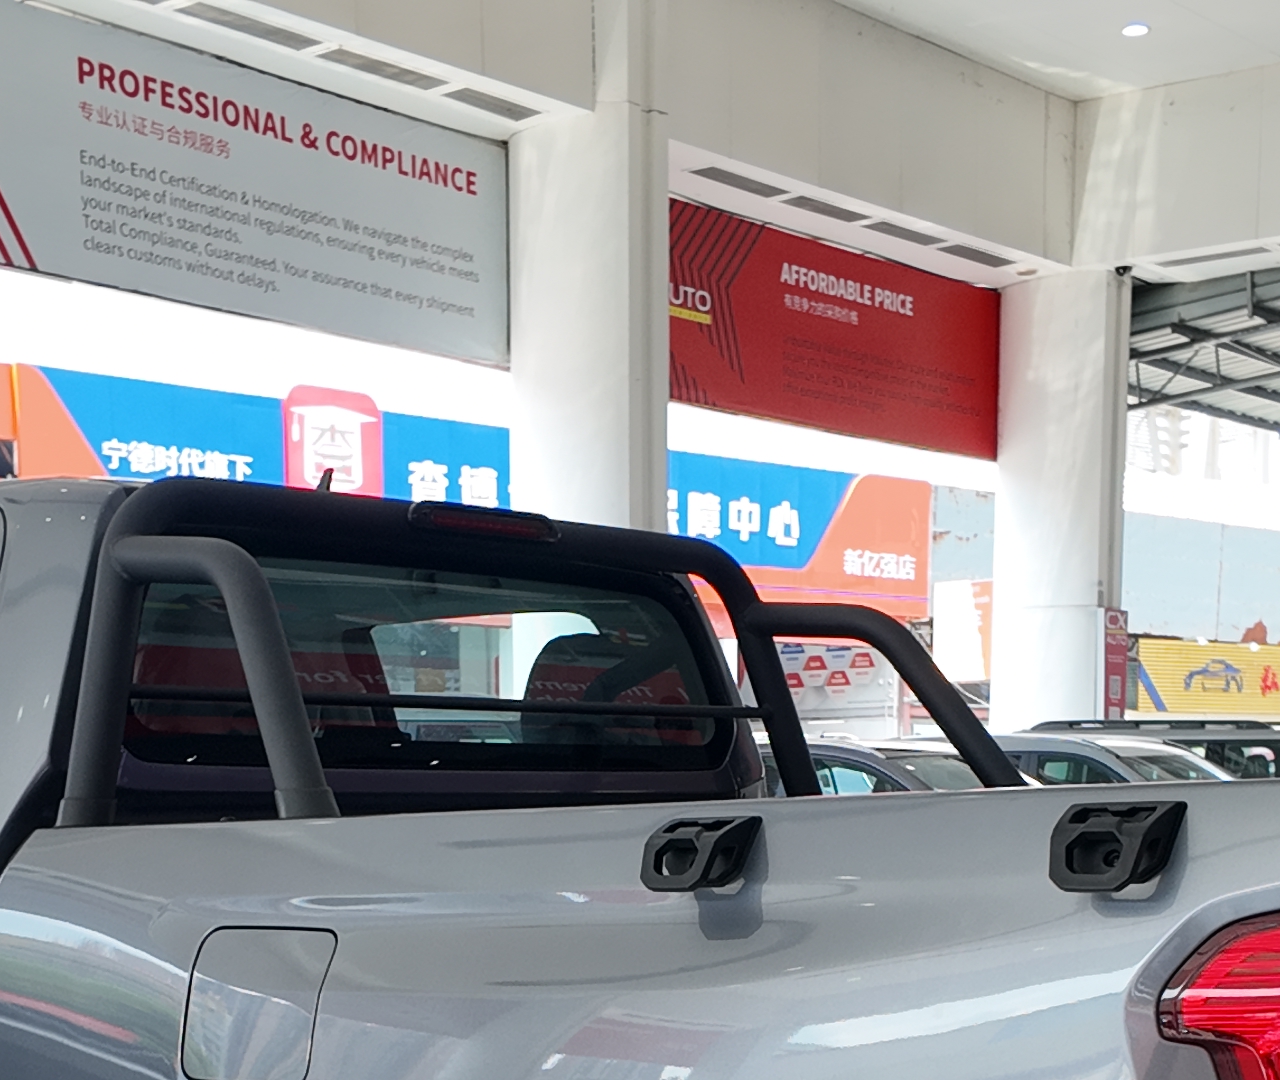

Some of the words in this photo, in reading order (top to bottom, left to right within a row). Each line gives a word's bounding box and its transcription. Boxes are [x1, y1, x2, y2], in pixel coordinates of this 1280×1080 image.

[77, 55, 294, 144] PROFESSIONAL
[300, 122, 320, 151] &
[325, 130, 479, 196] COMPLIANCE
[77, 100, 232, 161] 专业认证与合规服务
[79, 149, 157, 183] End-to-End
[159, 169, 238, 204] Certification
[239, 190, 250, 206] &
[251, 193, 341, 230] Homologation.
[341, 216, 360, 235] We
[362, 225, 409, 248] navigate
[410, 235, 429, 253] the
[429, 242, 475, 264] complex
[79, 169, 151, 202] landscape
[152, 189, 167, 205] of
[169, 191, 252, 227] international
[253, 216, 324, 248] regulations,
[325, 234, 376, 261] ensuring
[377, 248, 407, 269] every
[408, 256, 447, 275] vehicle
[448, 265, 480, 283] meets
[80, 195, 113, 213] your
[115, 202, 174, 228] market's
[175, 217, 243, 245] standards.
[81, 213, 117, 236] Total
[119, 221, 203, 258] Compliance,
[203, 242, 281, 274] Guaranteed.
[282, 260, 309, 280] Your
[311, 270, 369, 295] assurance
[369, 282, 394, 300] that
[394, 289, 425, 310] every
[425, 295, 476, 319] shipment
[82, 235, 125, 259] clears
[126, 247, 184, 272] customs
[184, 259, 236, 283] without
[236, 269, 281, 294] delays.
[780, 261, 873, 305] AFFORDABLE
[874, 288, 915, 317] PRICE
[669, 282, 712, 312] UTO
[101, 437, 254, 482] 宁德时代旗下
[1106, 611, 1126, 630] CX
